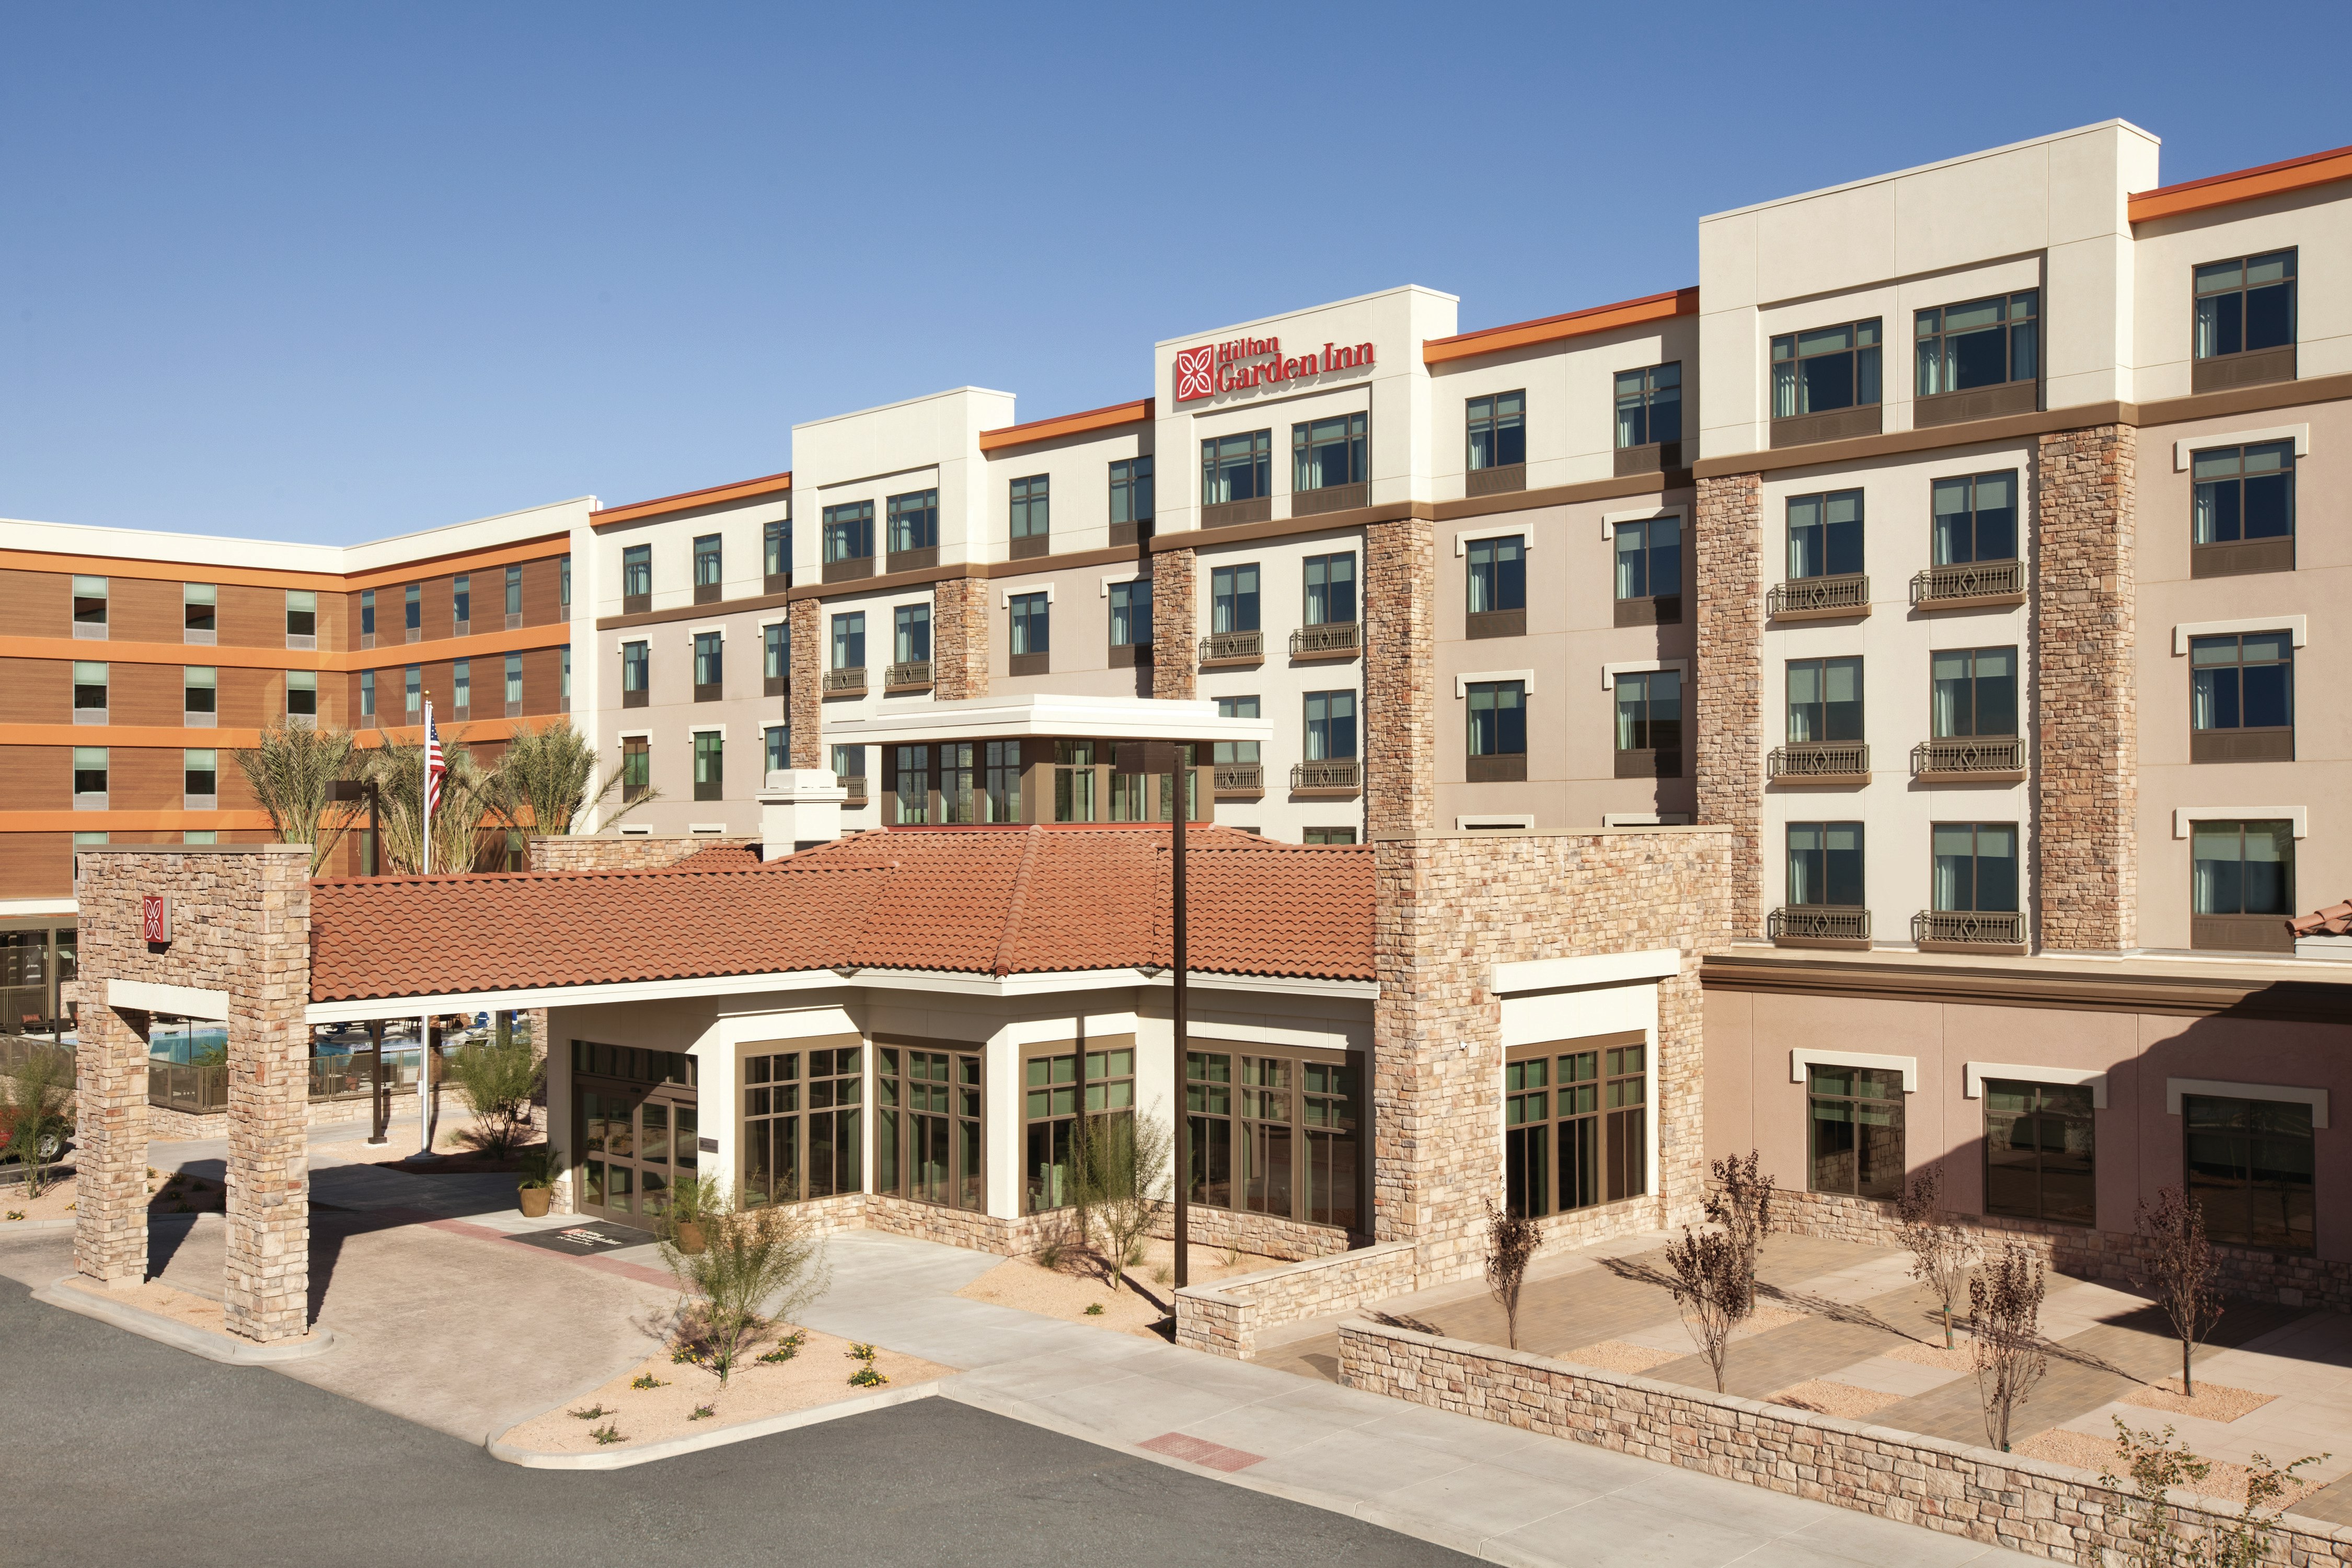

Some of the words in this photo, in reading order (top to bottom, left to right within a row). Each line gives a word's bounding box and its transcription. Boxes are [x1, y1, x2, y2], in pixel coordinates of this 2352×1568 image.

[1216, 353, 1319, 393] Garden
[1323, 342, 1375, 373] Inn
[1218, 336, 1279, 363] Hilton
